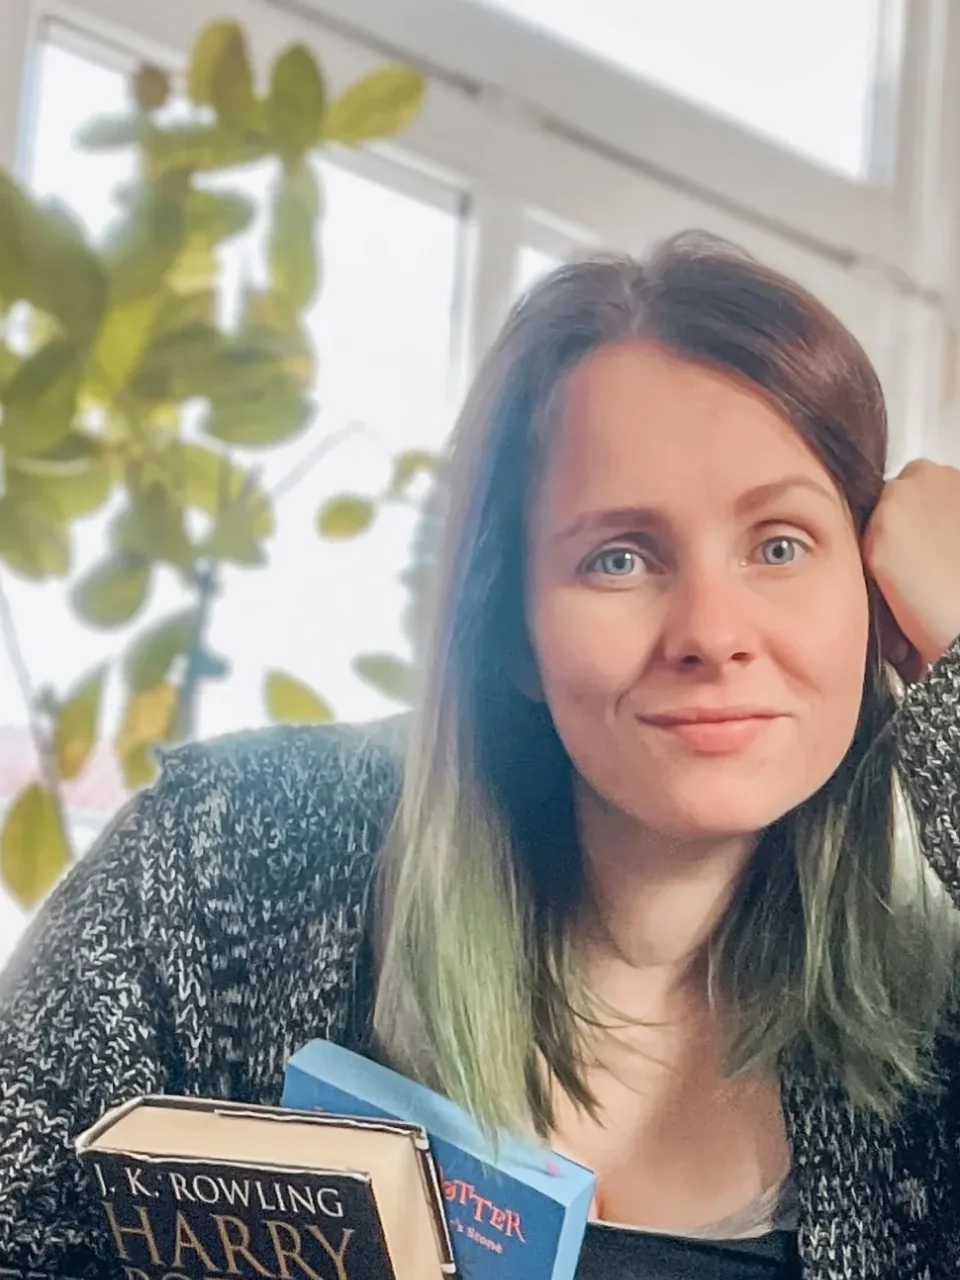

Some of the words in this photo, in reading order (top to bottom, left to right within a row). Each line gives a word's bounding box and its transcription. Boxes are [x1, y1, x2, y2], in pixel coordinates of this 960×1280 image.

[124, 1167, 161, 1198] K.
[169, 1172, 344, 1218] ROWLING
[439, 1166, 527, 1244] OTTER
